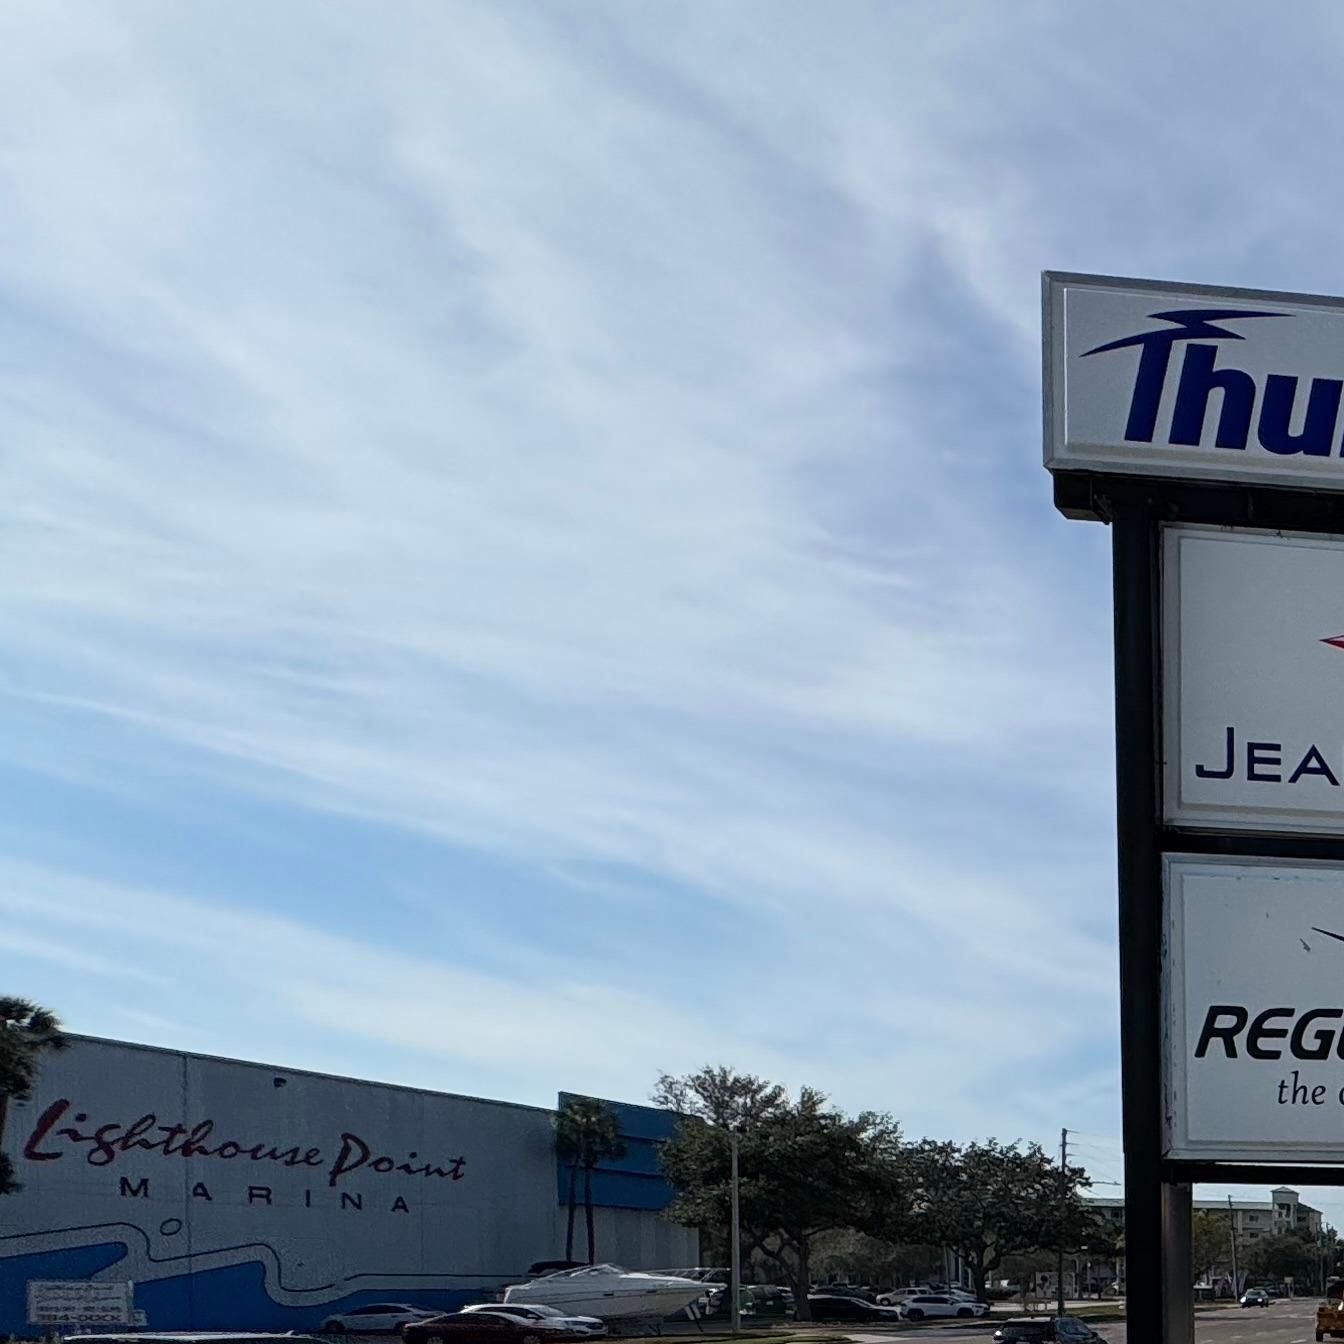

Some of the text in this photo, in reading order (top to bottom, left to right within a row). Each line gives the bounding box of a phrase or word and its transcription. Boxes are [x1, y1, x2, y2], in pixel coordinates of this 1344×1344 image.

[1277, 1070, 1326, 1106] the
[24, 1099, 467, 1187] Lighthouse Point
[119, 1176, 410, 1214] MARINA
